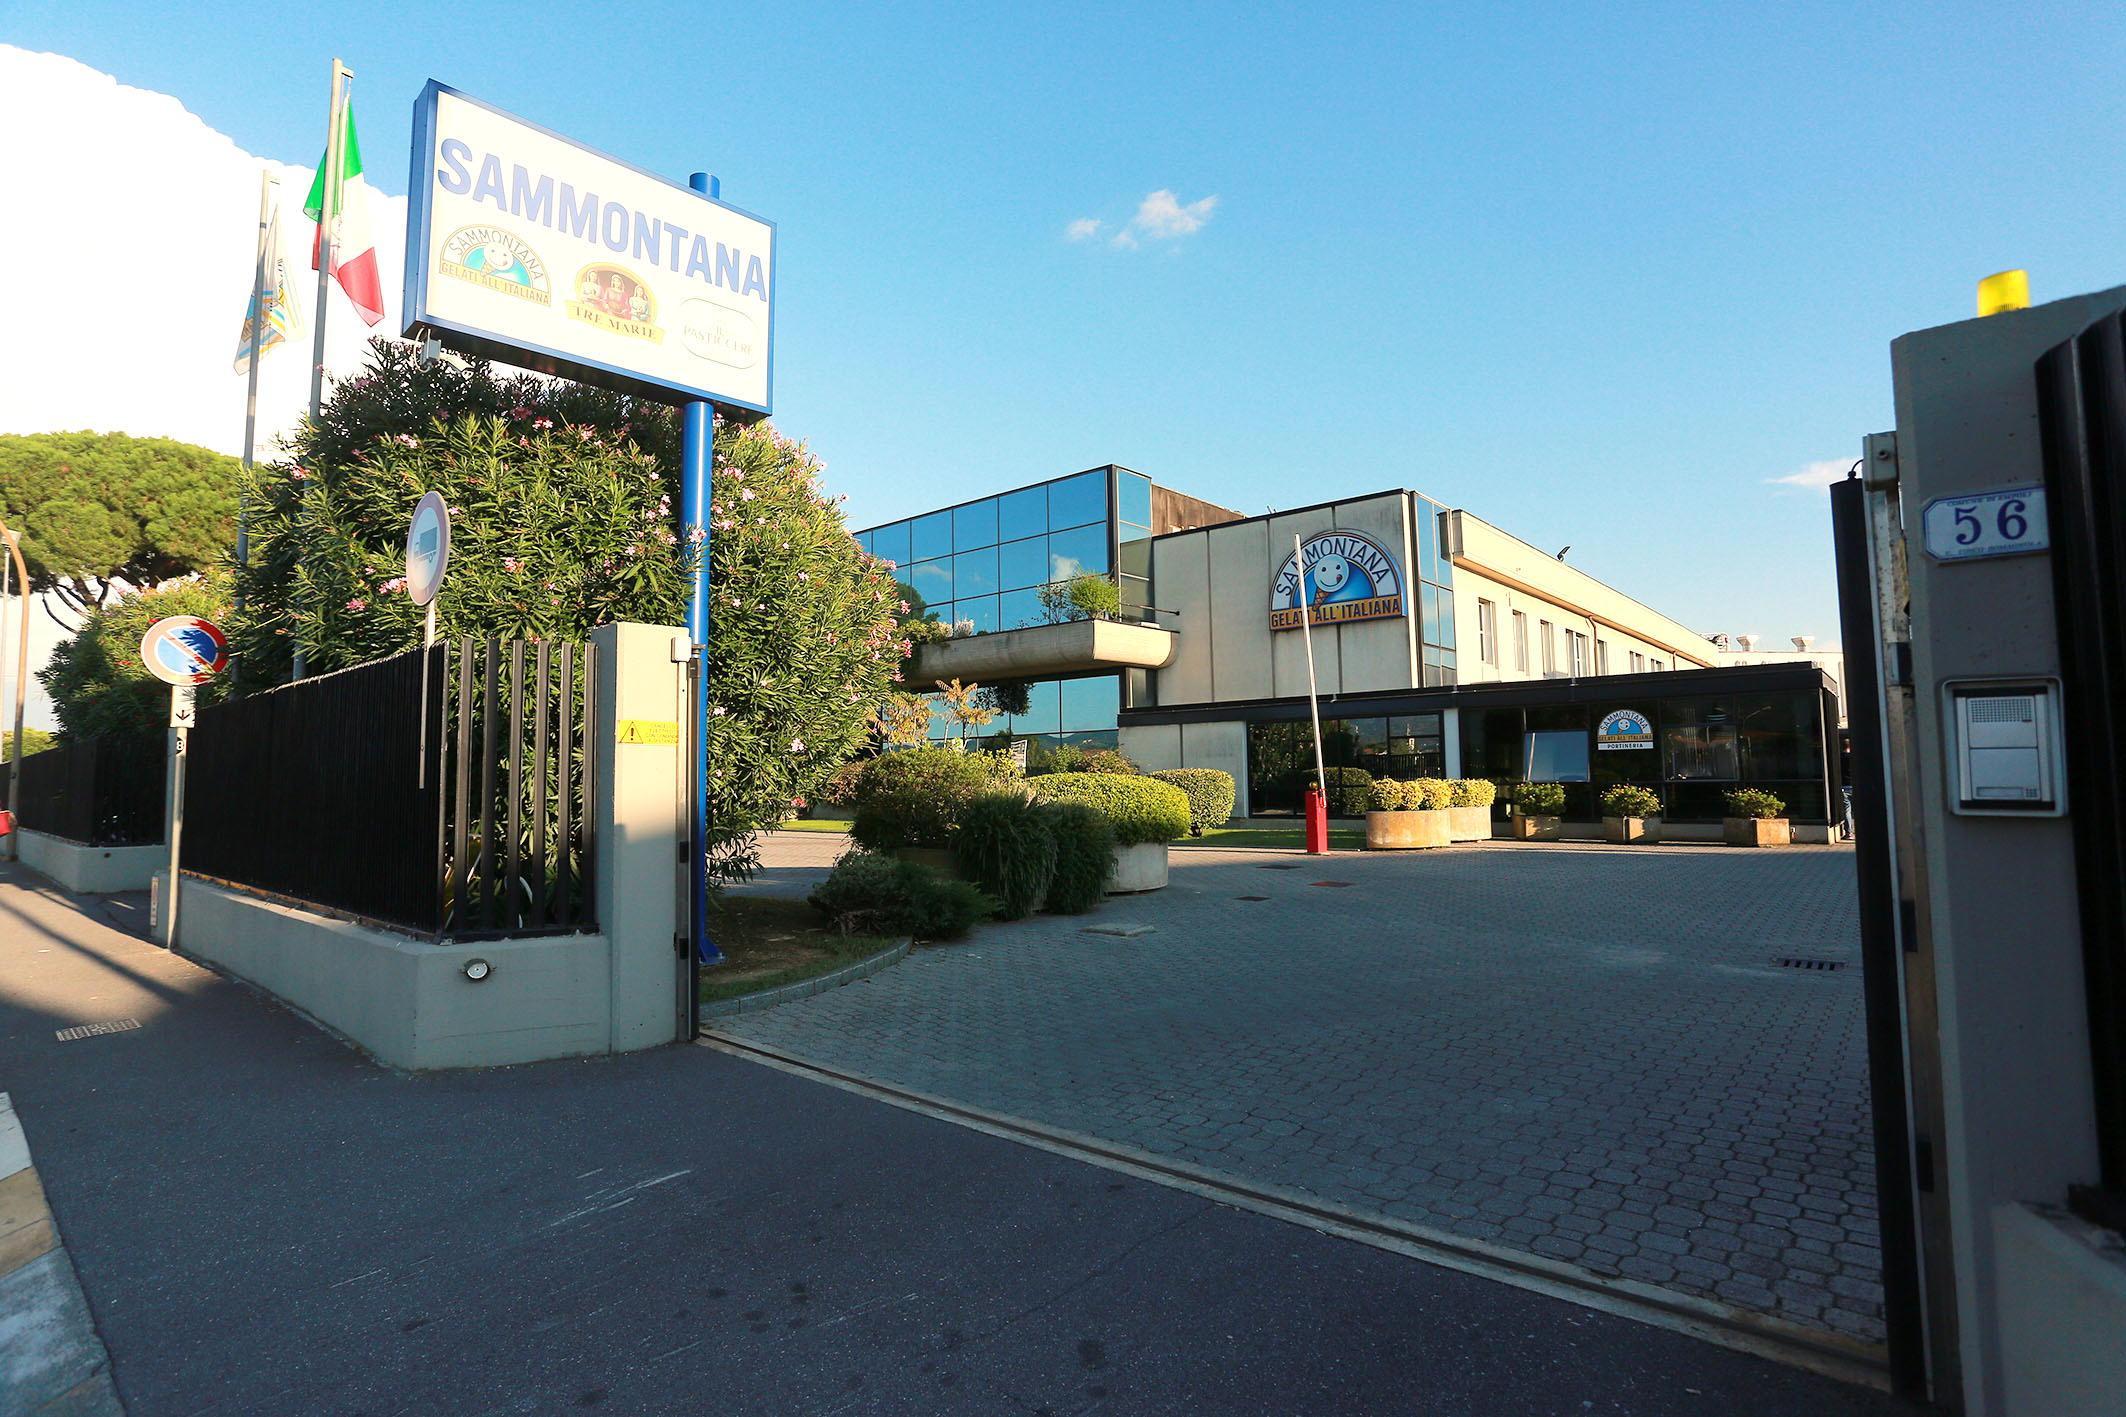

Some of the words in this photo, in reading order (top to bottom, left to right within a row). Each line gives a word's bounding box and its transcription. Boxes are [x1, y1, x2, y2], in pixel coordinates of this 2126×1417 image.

[437, 138, 767, 302] SAMMONTANA
[448, 228, 544, 280] SAMMONTANA
[441, 262, 478, 282] GELATI
[575, 306, 602, 323] TRE
[608, 318, 656, 340] MARIE
[1954, 499, 2028, 546] 56
[1315, 599, 1400, 622] ALL'ITALIANA
[1600, 710, 1648, 731] SAMMONTANA
